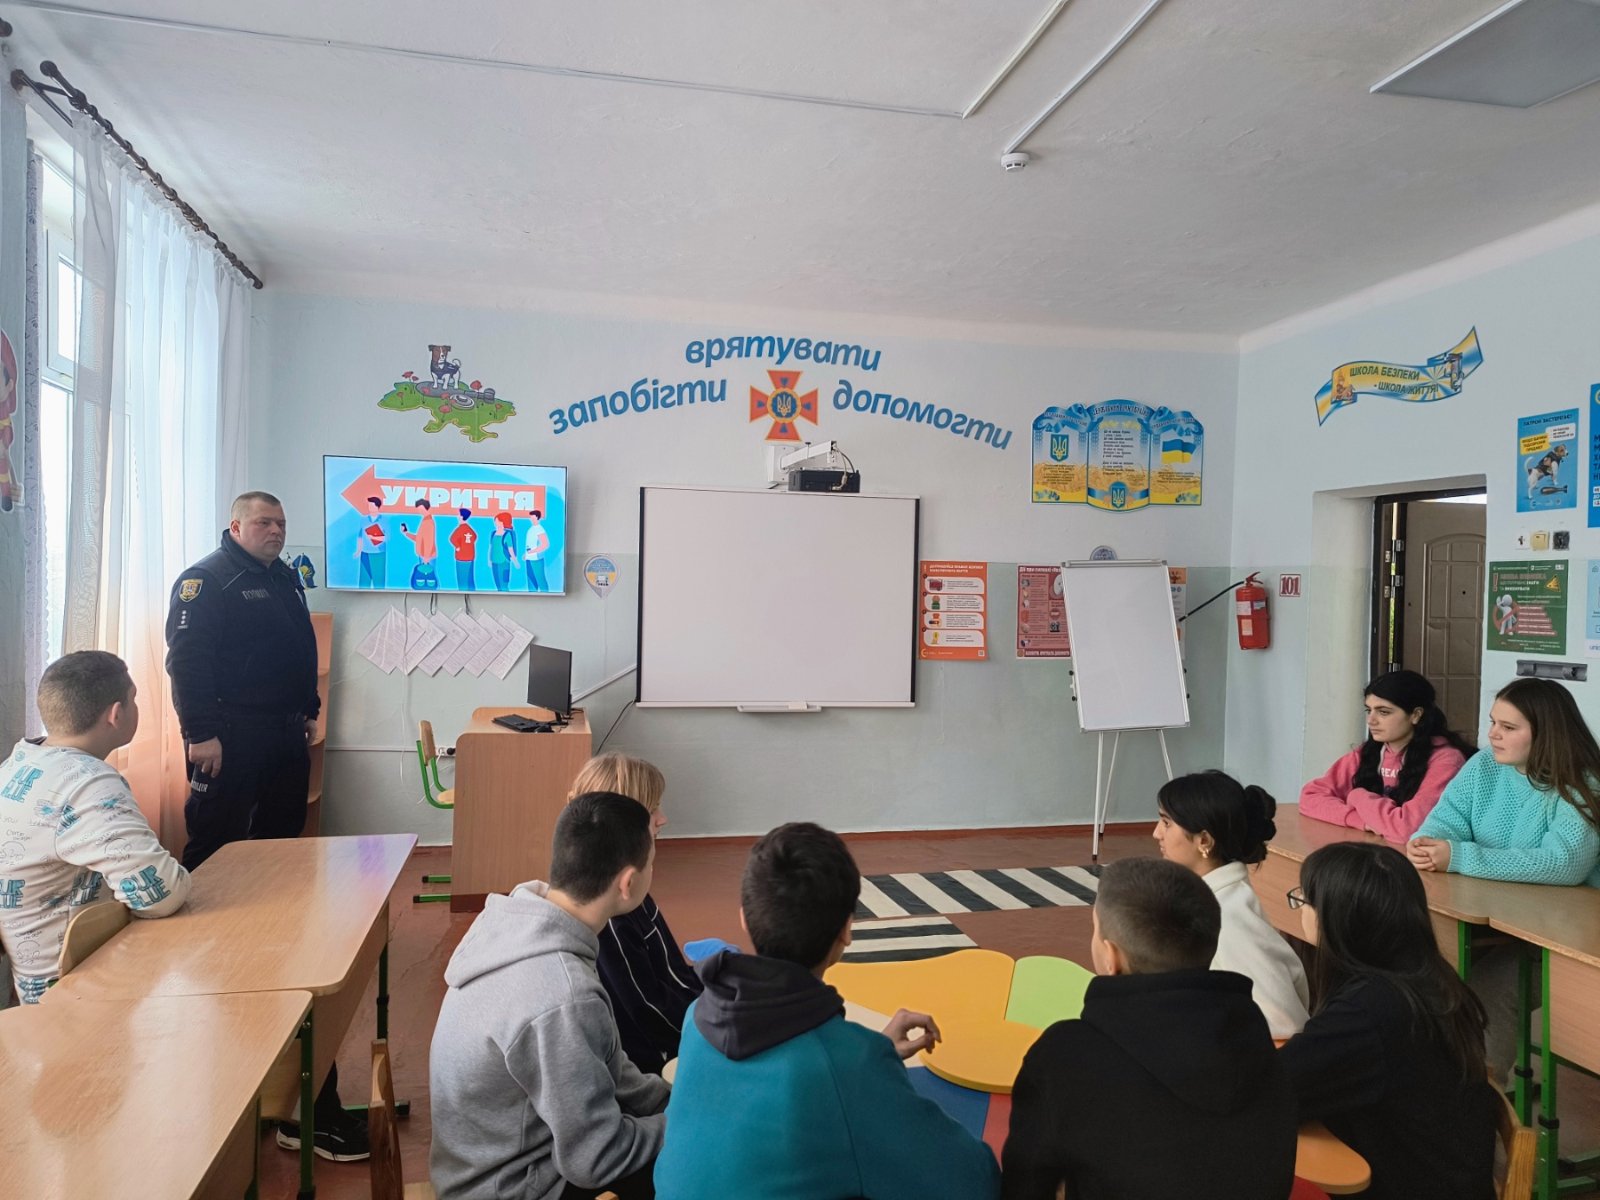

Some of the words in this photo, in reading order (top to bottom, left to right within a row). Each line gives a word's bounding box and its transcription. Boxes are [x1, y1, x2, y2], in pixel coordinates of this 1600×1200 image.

[685, 335, 882, 371] врятувати
[1350, 365, 1379, 377] ШКОЛА
[1381, 366, 1420, 381] БЕЗПЕКИ
[1378, 381, 1406, 393] ШКОЛА
[549, 378, 727, 434] запобігти
[832, 379, 1013, 450] допомогти
[380, 485, 535, 511] УКРИТТЯ
[1281, 576, 1300, 595] 101
